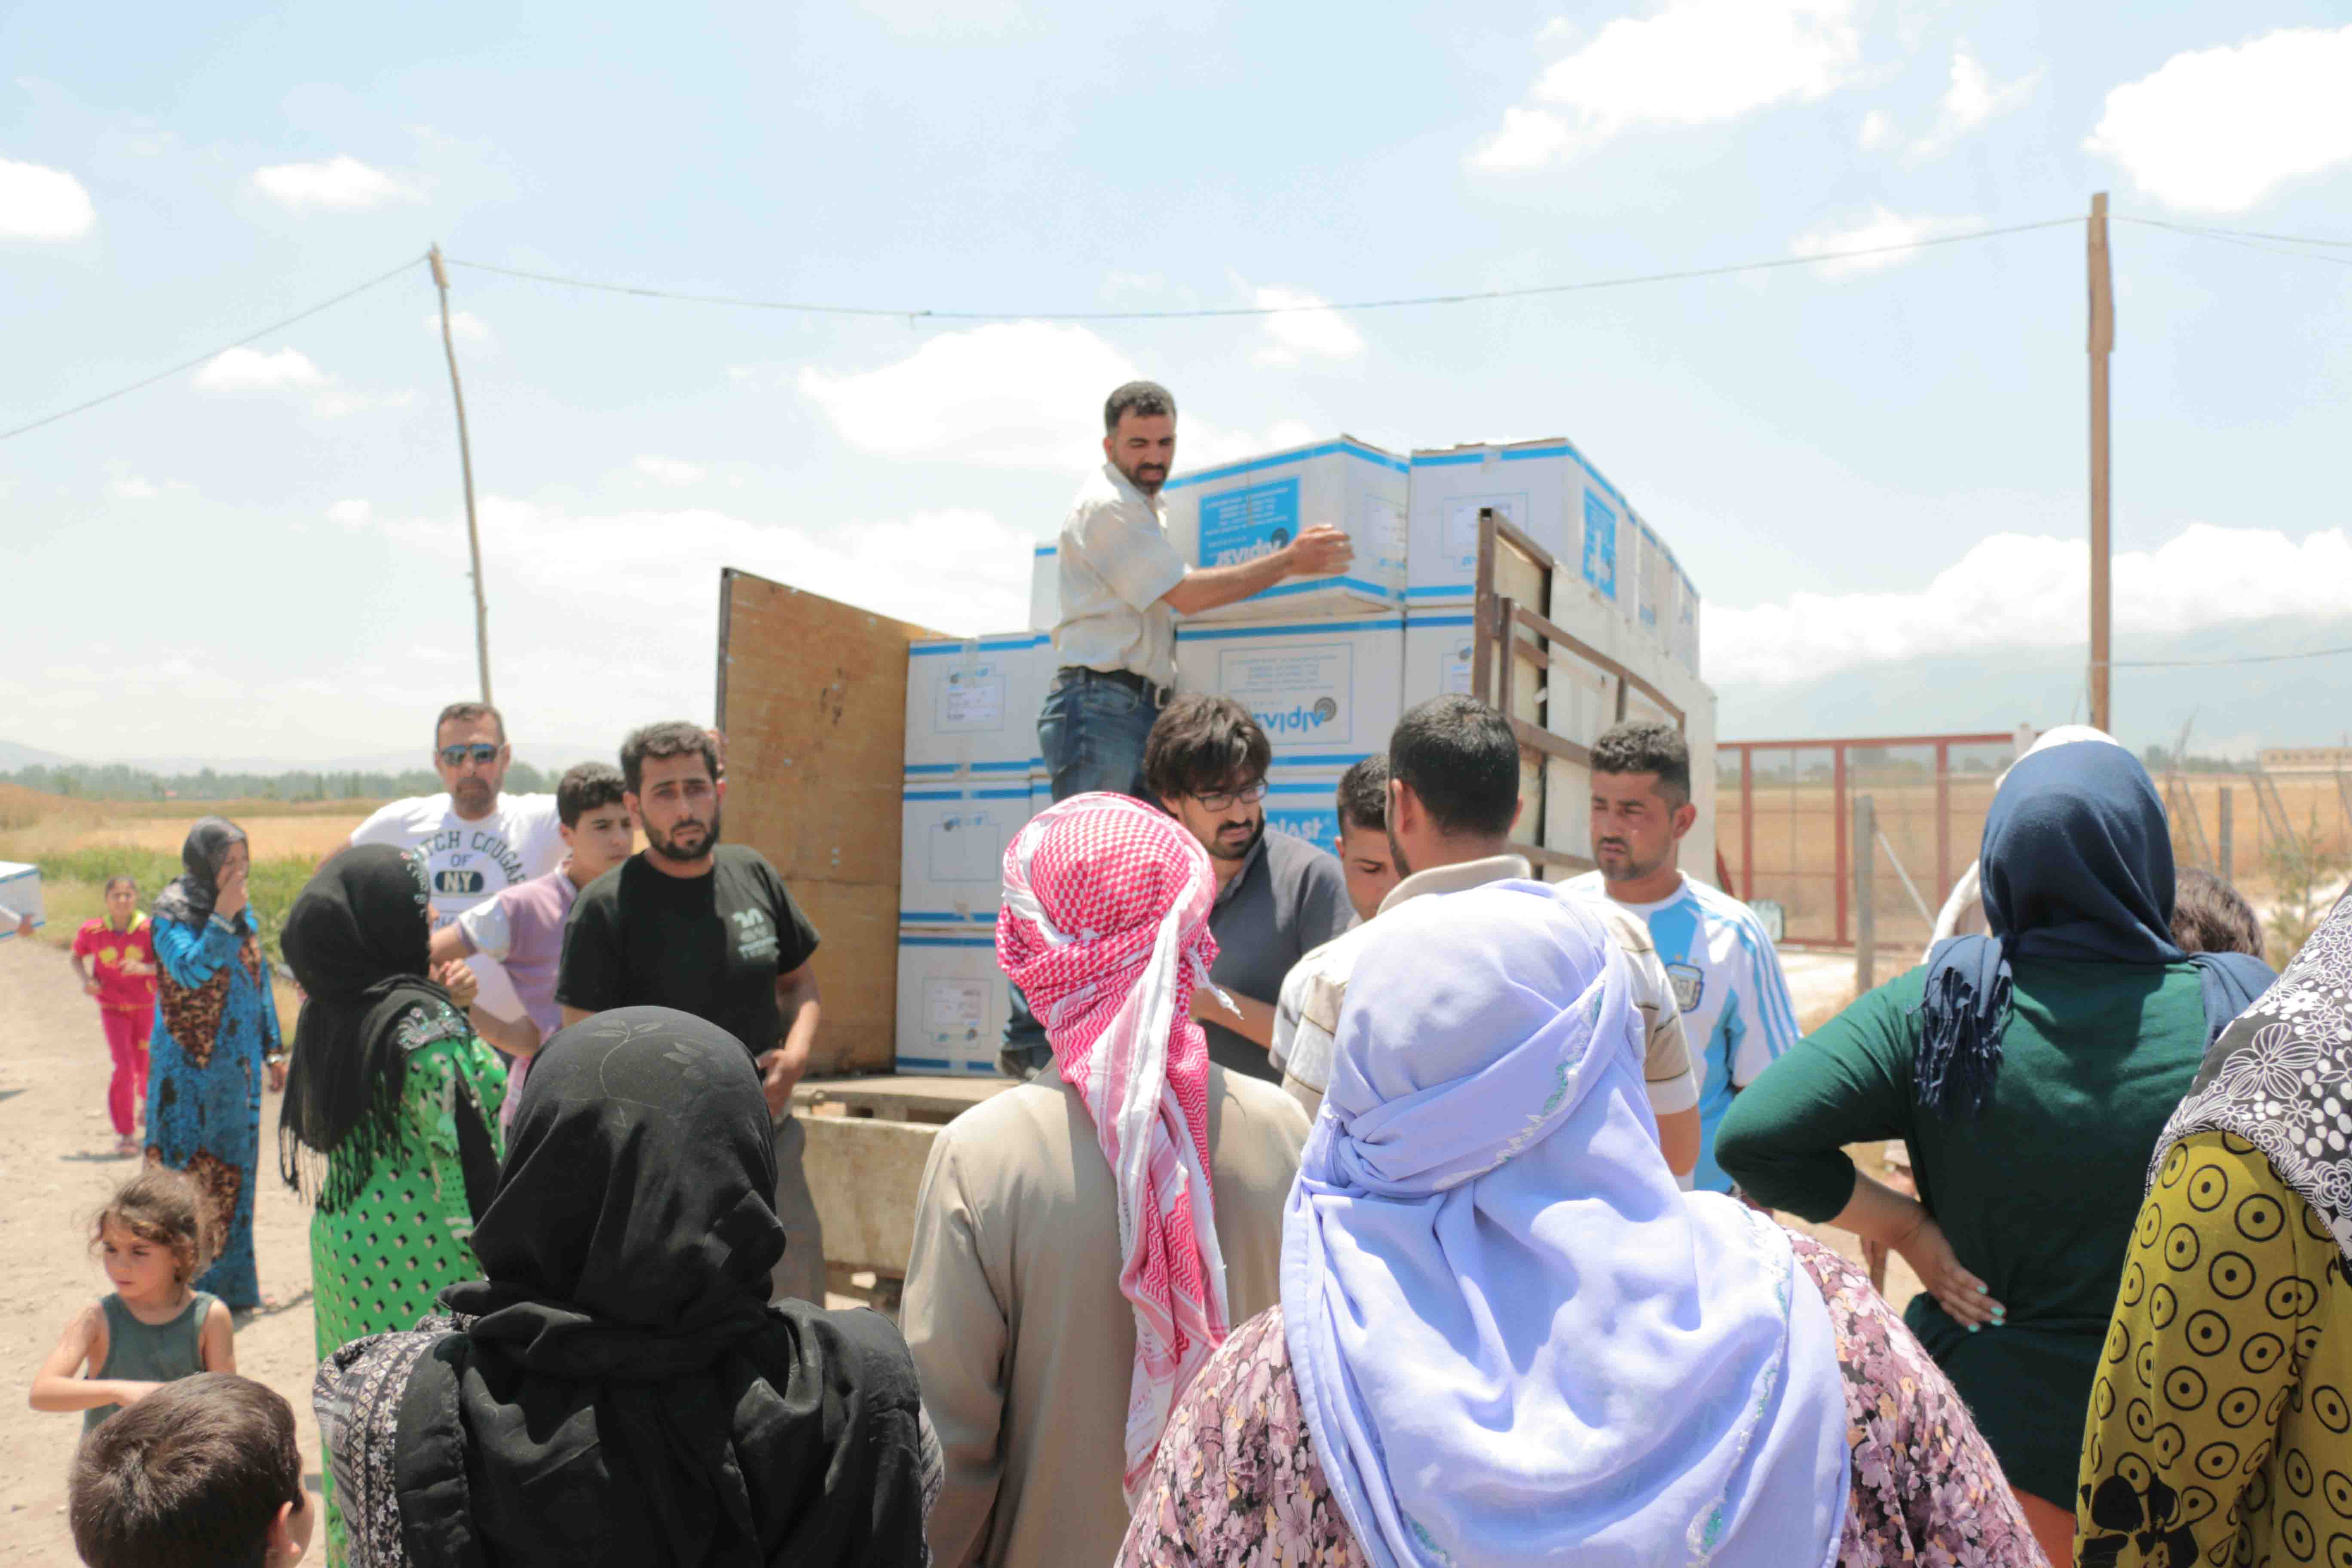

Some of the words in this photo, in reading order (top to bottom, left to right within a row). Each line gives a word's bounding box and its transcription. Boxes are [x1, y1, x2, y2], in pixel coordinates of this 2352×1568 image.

[420, 830, 461, 856] TCH
[450, 853, 472, 867] OF
[443, 872, 474, 894] NY
